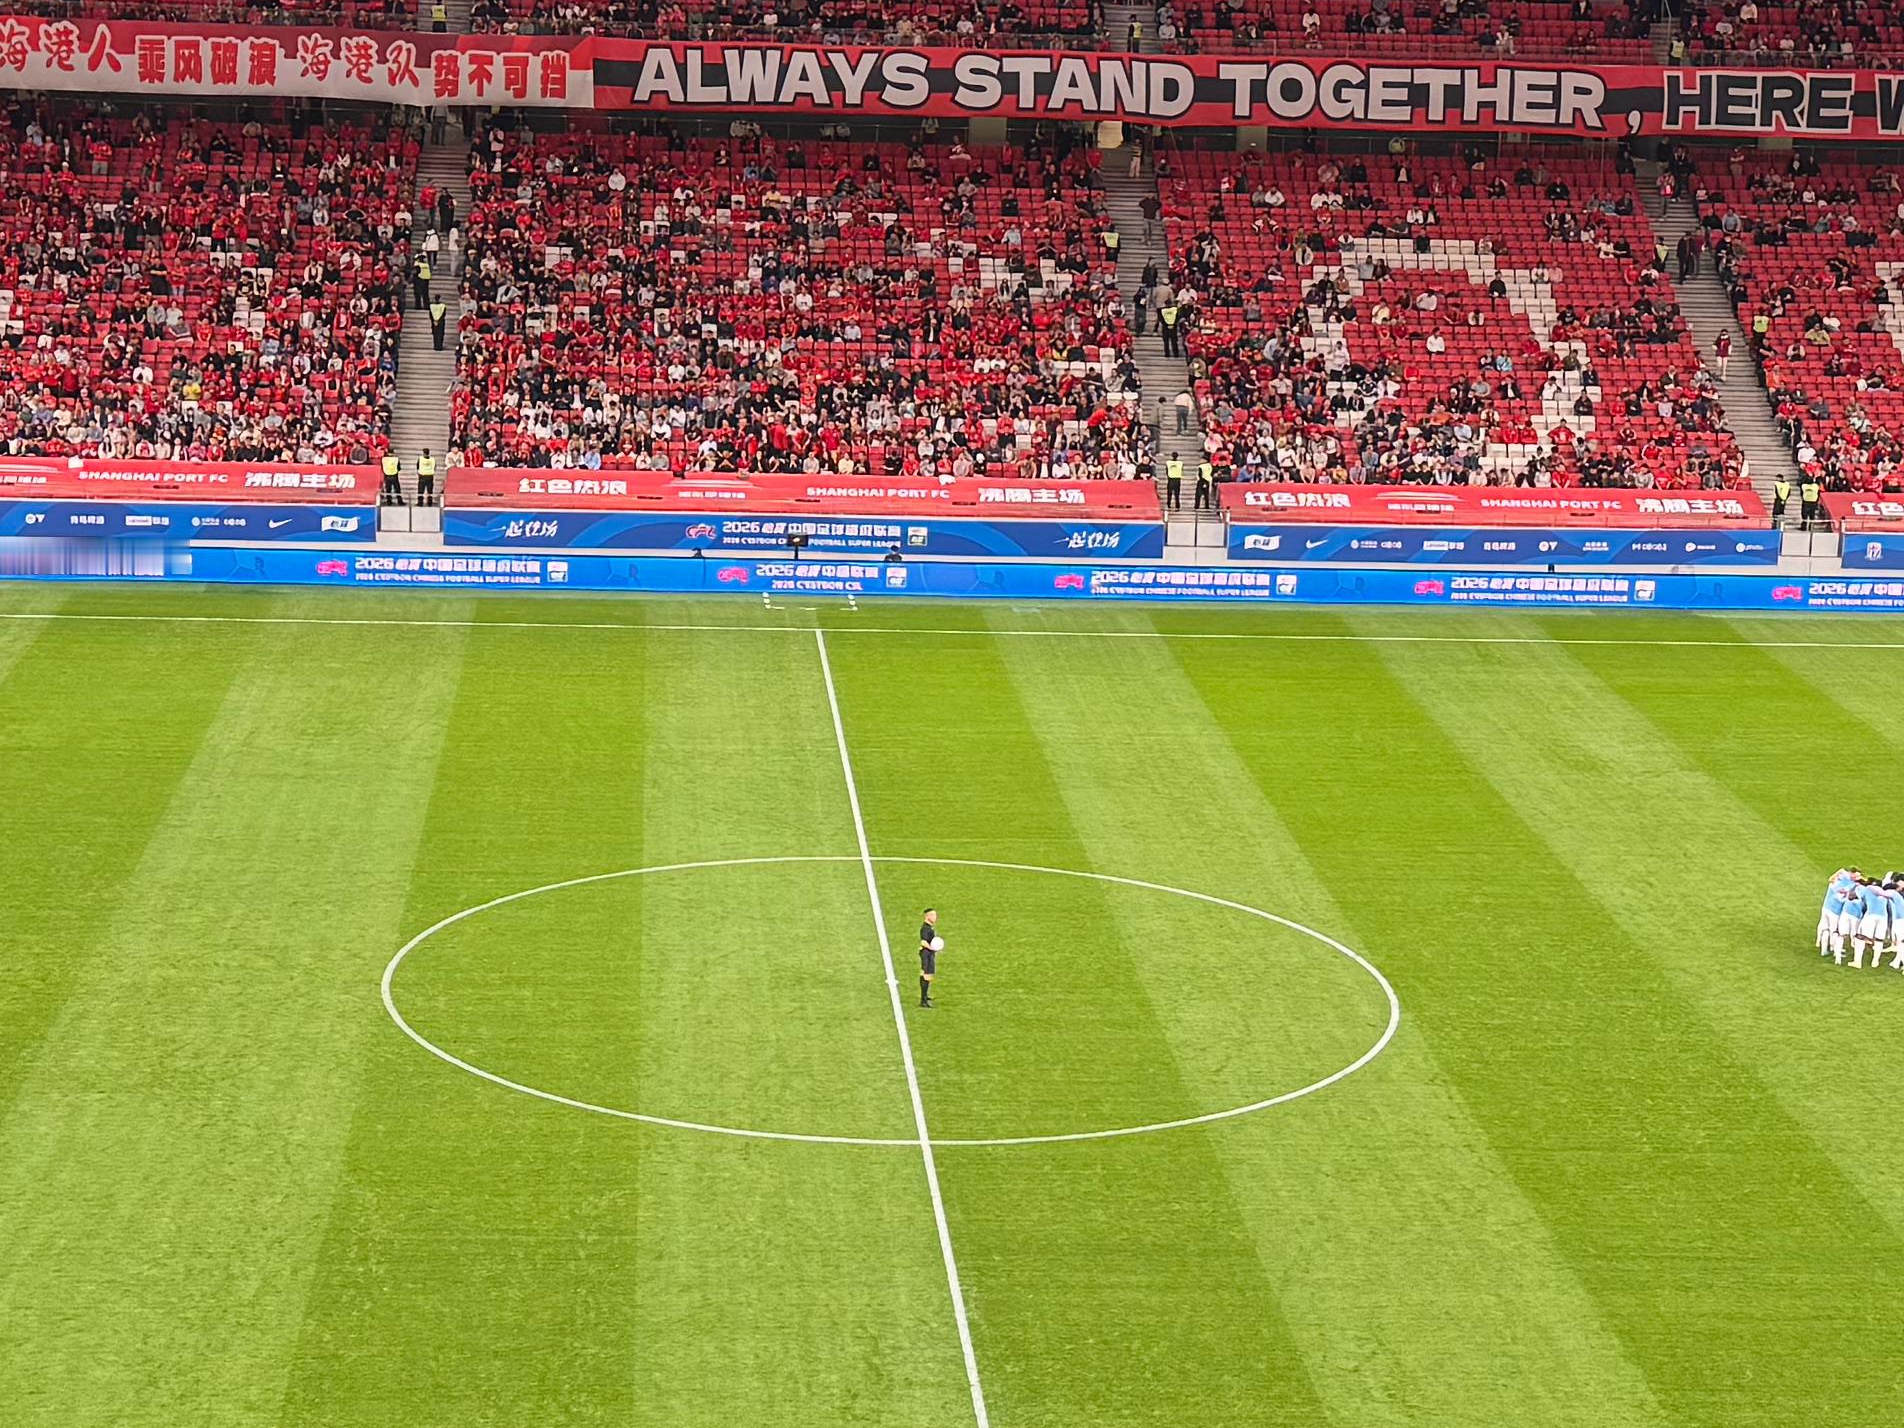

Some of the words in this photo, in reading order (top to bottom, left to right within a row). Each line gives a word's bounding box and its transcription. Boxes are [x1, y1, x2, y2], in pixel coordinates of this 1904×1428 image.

[632, 46, 930, 105] ALWAYS
[953, 54, 1196, 118] STAND
[1663, 71, 1856, 132] HERE
[79, 471, 159, 481] SHANGHAI
[163, 473, 205, 483] PORT
[210, 474, 228, 483] FC
[806, 487, 884, 497] SHANGHAI
[887, 488, 929, 498] PORT
[931, 489, 950, 499] FC
[1481, 499, 1557, 508] SHANGHAI
[1560, 500, 1600, 510] PORT
[1603, 501, 1623, 510] FC
